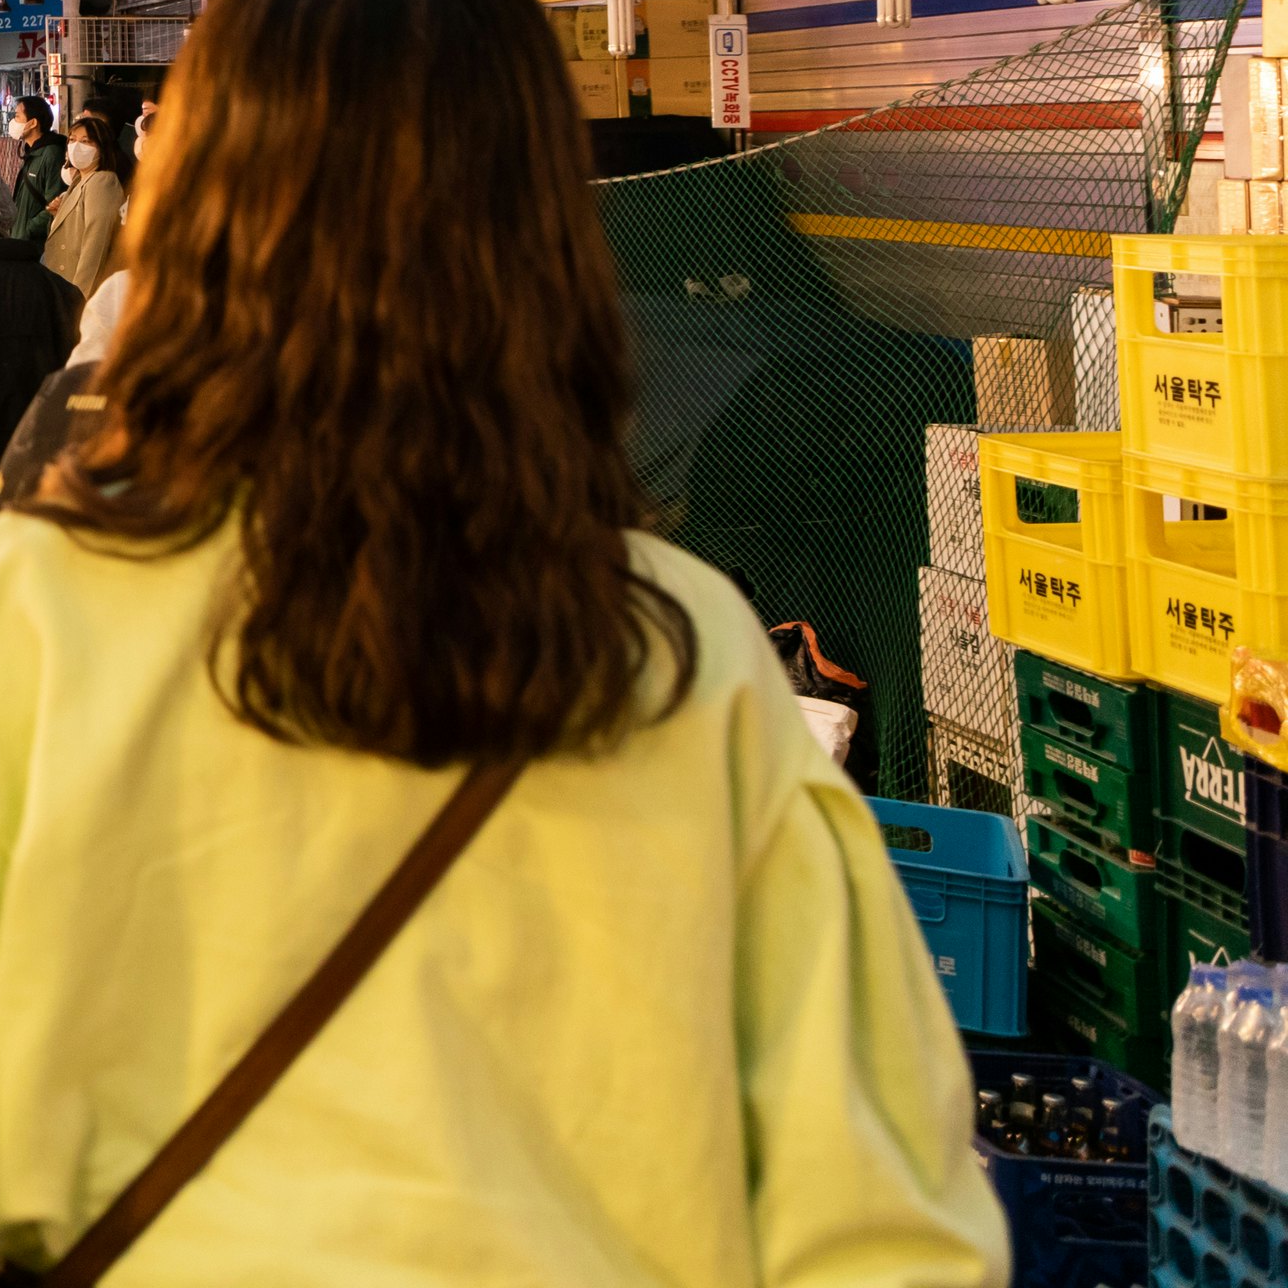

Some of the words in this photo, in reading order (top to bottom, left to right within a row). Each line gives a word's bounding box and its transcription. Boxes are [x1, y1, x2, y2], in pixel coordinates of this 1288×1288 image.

[1154, 374, 1222, 408] 서울탁주
[1019, 567, 1082, 607] 서울탁주
[1165, 597, 1236, 641] 서울탁주
[1179, 745, 1247, 818] TERRA
